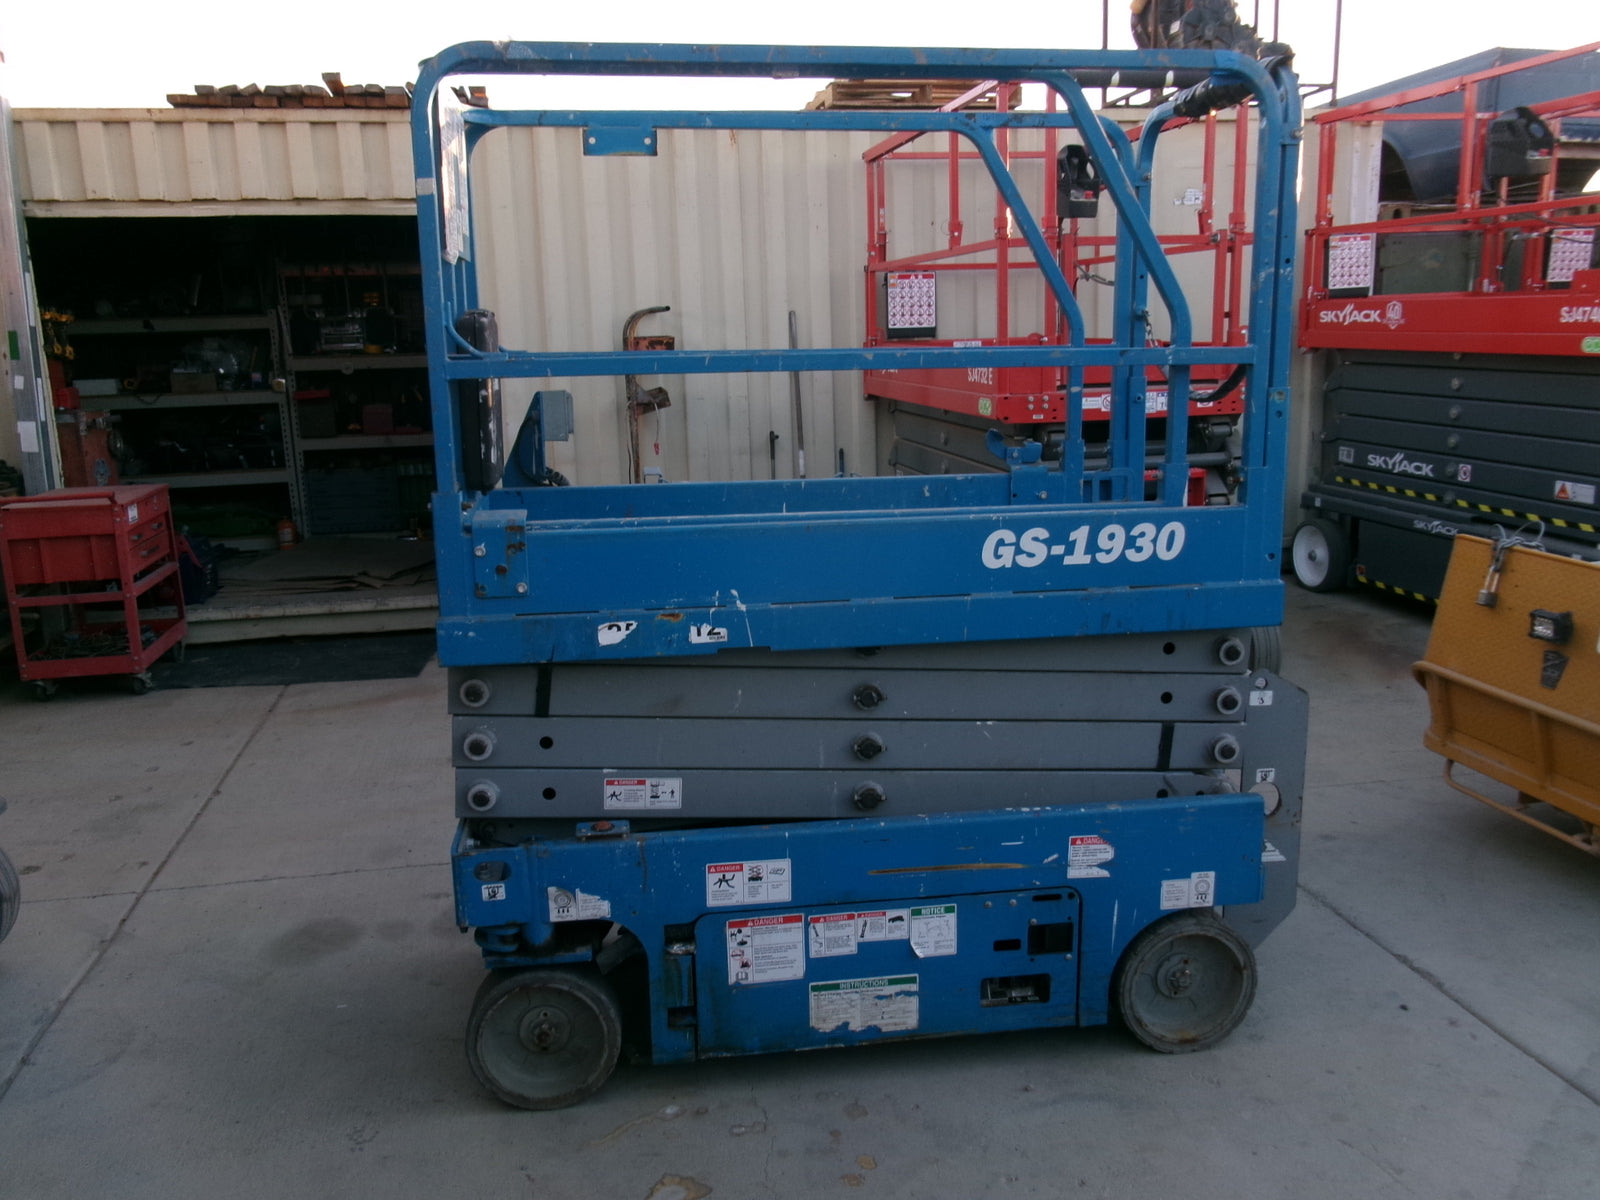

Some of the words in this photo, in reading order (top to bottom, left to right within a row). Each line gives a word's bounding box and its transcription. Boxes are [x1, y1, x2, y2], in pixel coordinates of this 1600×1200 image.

[1319, 303, 1382, 326] SKYJACK
[1559, 306, 1600, 323] SJ474
[1367, 452, 1434, 477] SKYJACK
[981, 521, 1186, 569] GS-1930
[716, 865, 741, 873] DANGER
[921, 906, 945, 915] NOTICE
[754, 917, 783, 926] DANGER
[839, 979, 889, 990] INSTRUCTIONS
